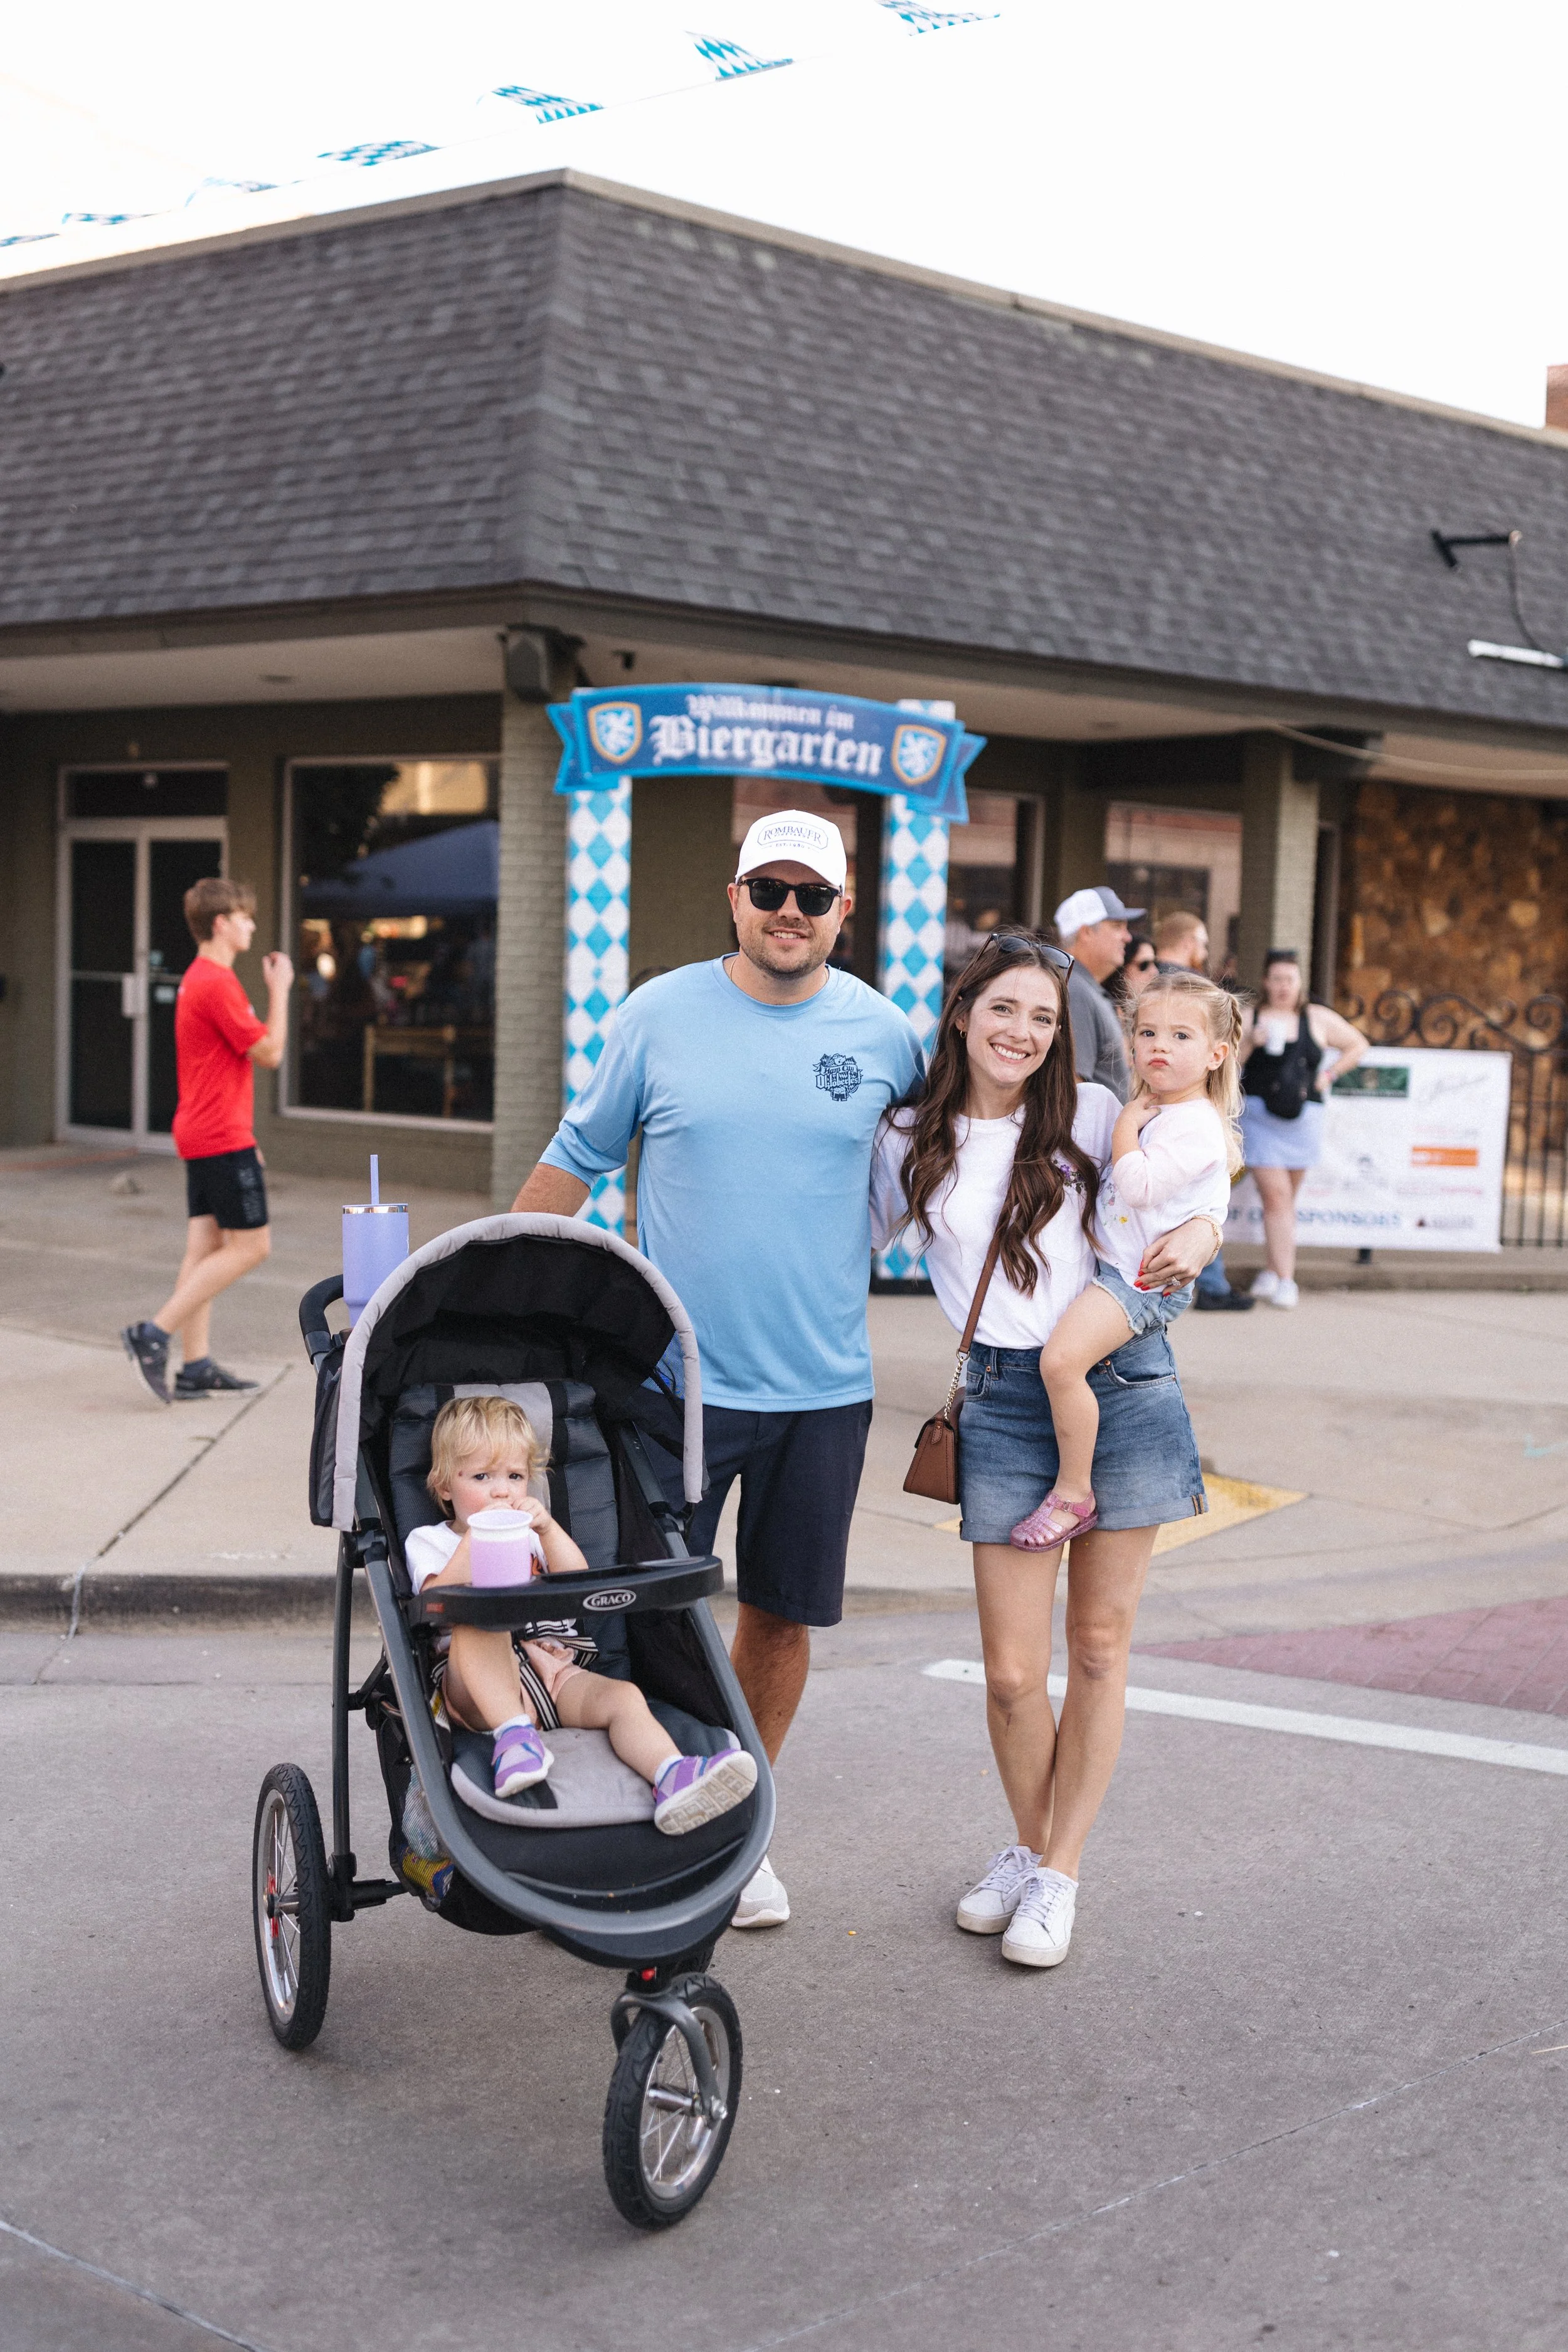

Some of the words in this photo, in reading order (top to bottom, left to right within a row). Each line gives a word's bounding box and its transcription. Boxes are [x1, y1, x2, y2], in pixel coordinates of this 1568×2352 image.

[649, 714, 885, 776] Biergarten
[763, 826, 821, 844] ROMBAUER
[815, 1071, 861, 1090] Oktoberfest
[591, 1592, 631, 1607] GRACO
